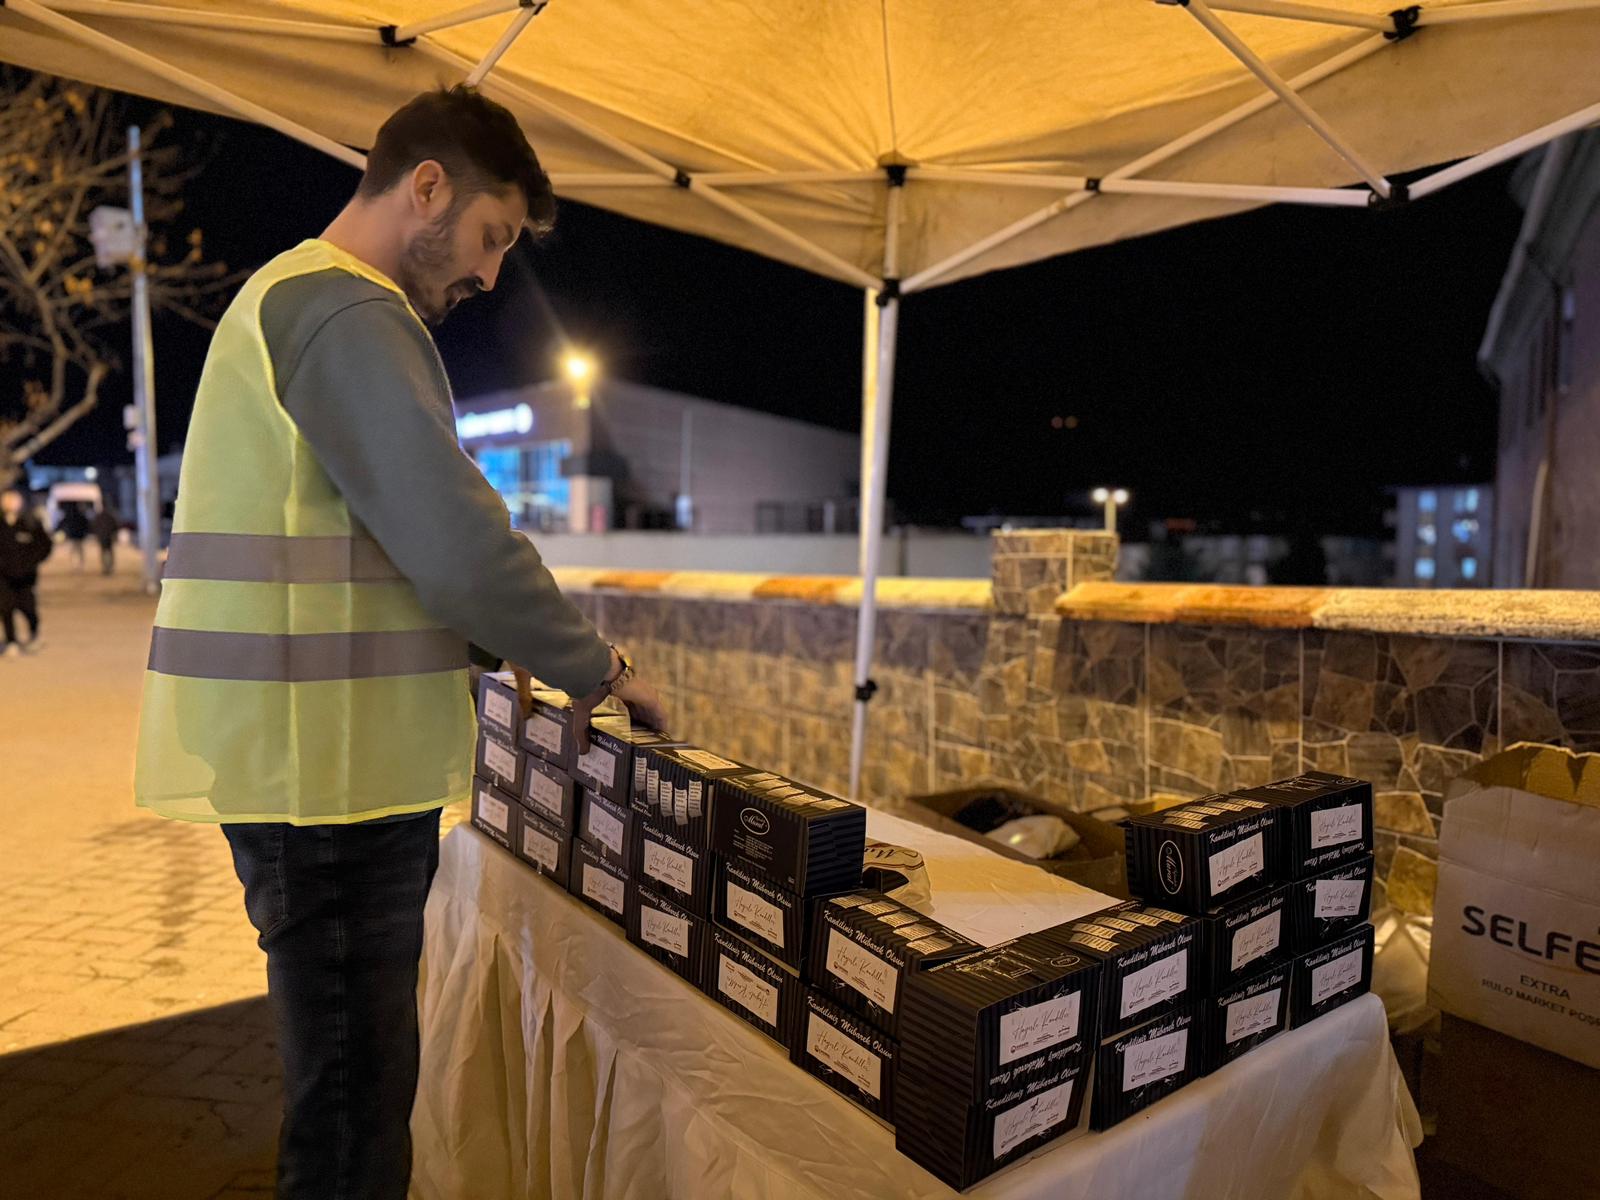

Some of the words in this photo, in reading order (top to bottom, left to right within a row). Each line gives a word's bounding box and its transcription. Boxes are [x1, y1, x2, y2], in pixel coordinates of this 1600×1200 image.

[856, 930, 884, 955] Mübarek
[886, 949, 904, 968] Olsun
[1150, 940, 1176, 958] Mübarek
[1177, 934, 1192, 946] Olsun
[1482, 978, 1513, 996] RULO
[1516, 991, 1566, 1014] MARKET
[1520, 974, 1570, 1000] EXTRA
[841, 1018, 870, 1046] Mübarek
[872, 1040, 893, 1060] Olsun
